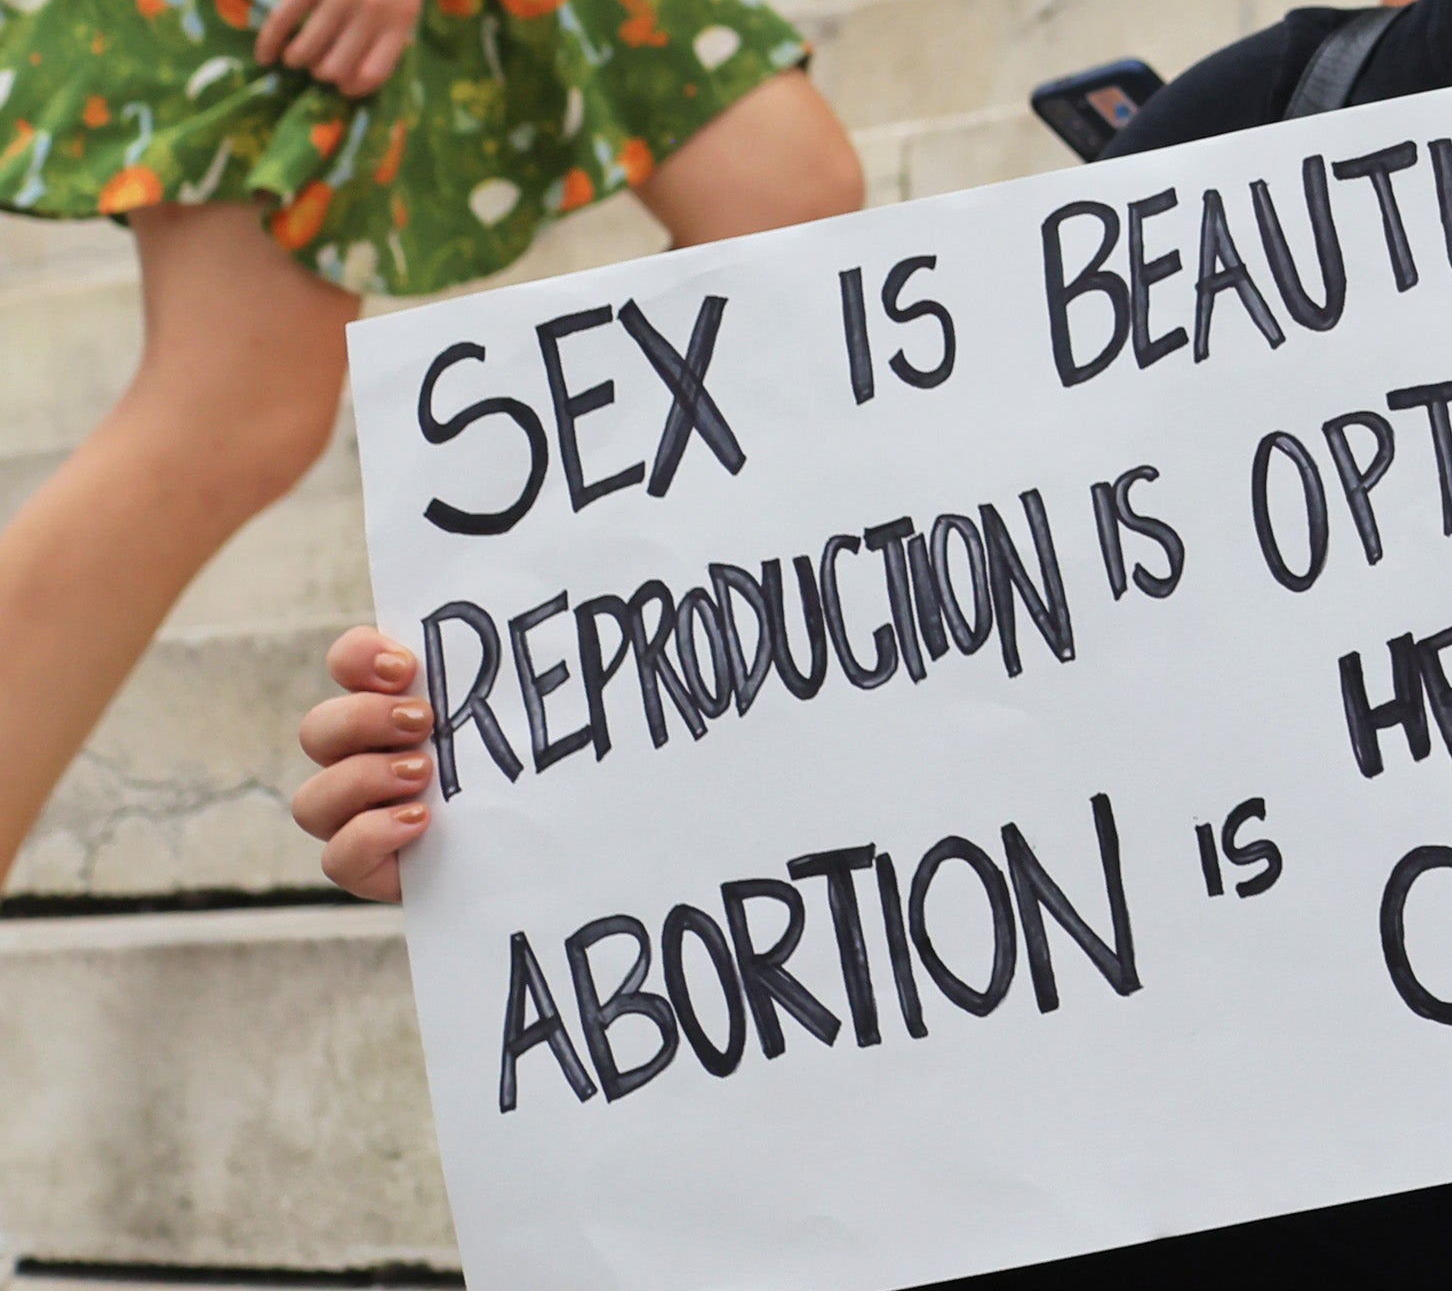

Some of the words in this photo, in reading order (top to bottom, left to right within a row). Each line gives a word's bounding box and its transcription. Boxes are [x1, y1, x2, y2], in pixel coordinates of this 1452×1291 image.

[418, 294, 747, 534] SEX
[841, 254, 957, 405] IS
[421, 488, 1076, 800] REPRODUCTION
[1092, 464, 1185, 600] IS
[498, 792, 1144, 1114] ABORTION
